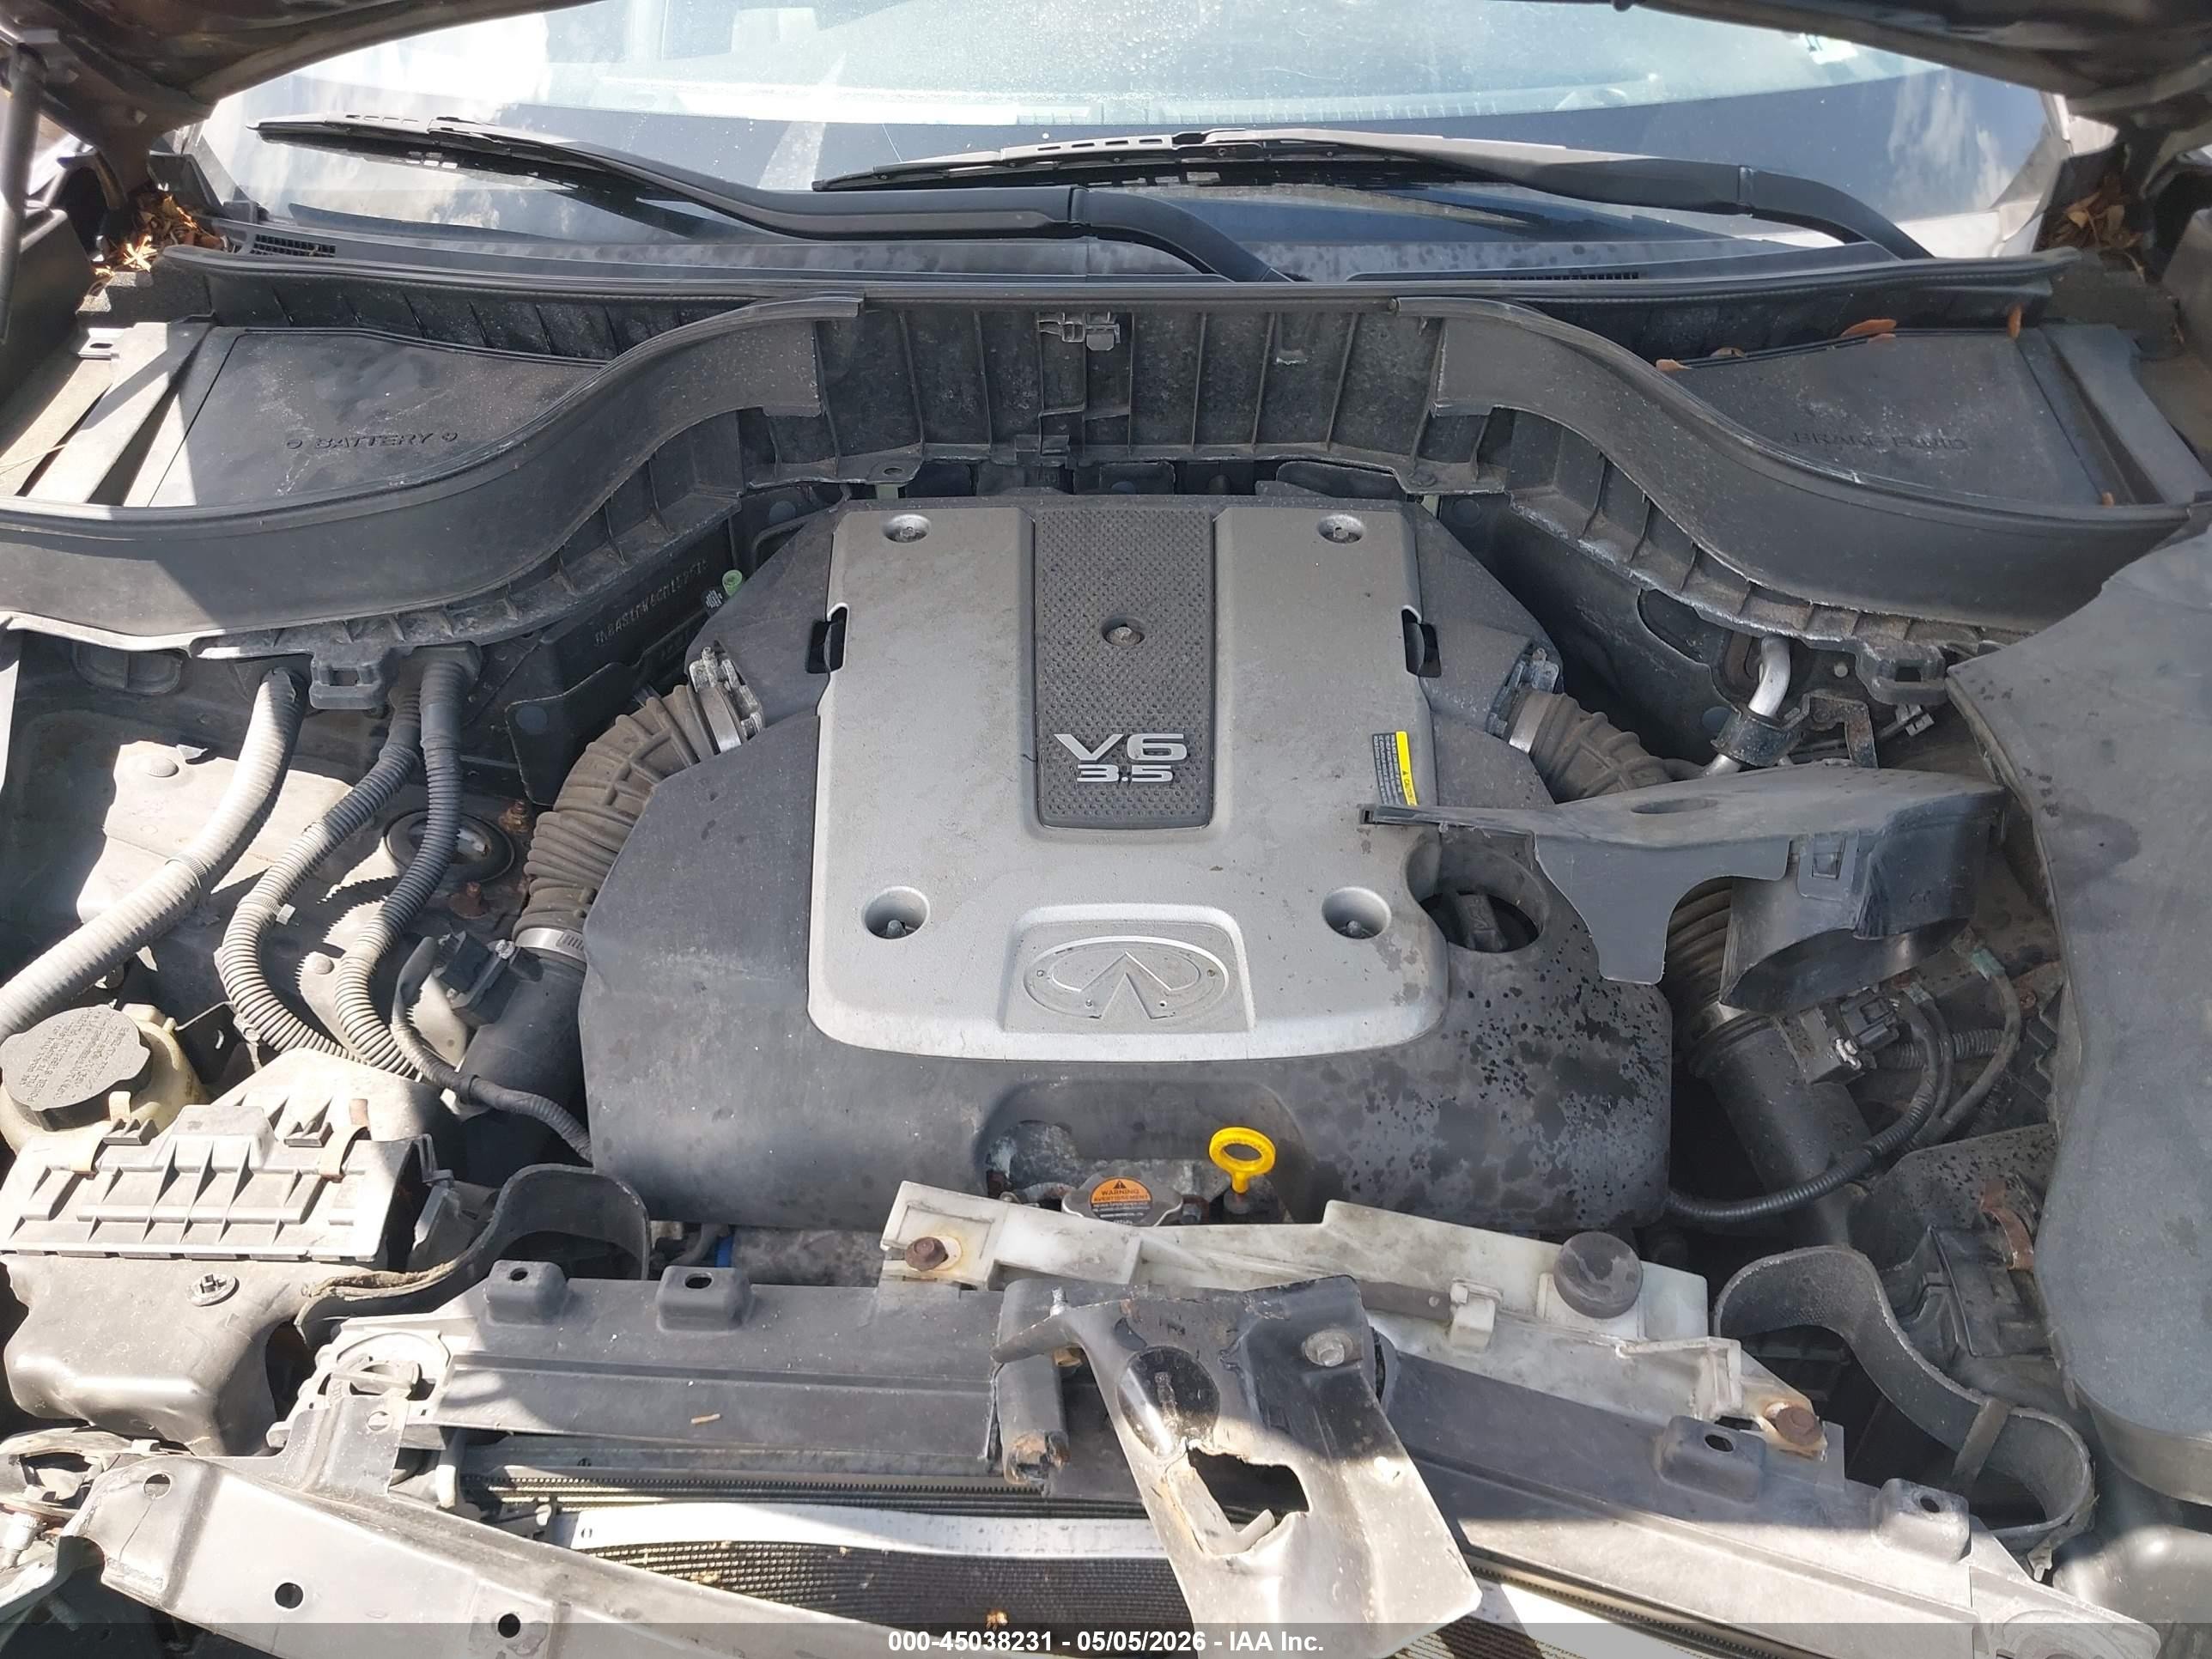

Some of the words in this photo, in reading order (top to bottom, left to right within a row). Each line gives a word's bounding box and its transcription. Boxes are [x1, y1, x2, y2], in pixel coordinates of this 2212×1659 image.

[315, 432, 434, 449] BATTERY
[1054, 733, 1188, 761] V6
[1076, 764, 1174, 782] 3.5
